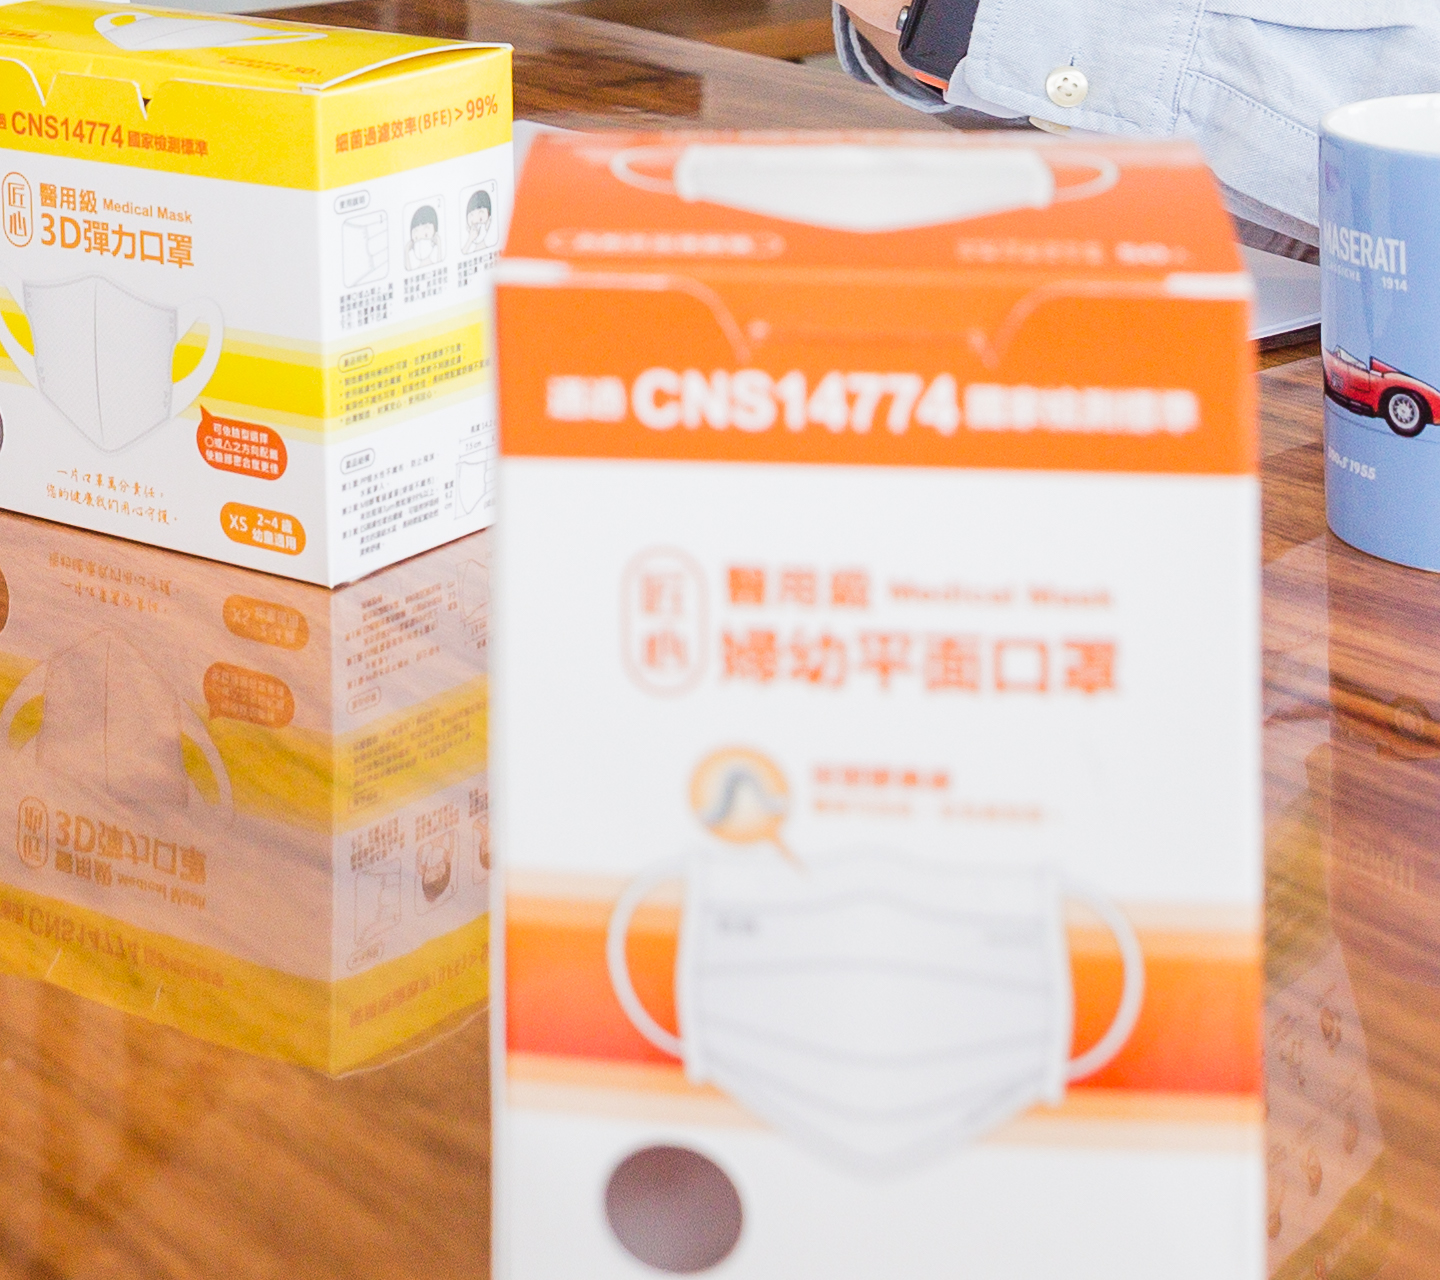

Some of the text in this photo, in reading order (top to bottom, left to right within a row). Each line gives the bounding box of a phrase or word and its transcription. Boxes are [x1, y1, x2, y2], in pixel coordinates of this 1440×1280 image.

[11, 111, 124, 148] CNS14774
[39, 182, 193, 224] 醫用級 Medical Mask
[40, 212, 195, 269] 3D彈力口罩
[1381, 276, 1408, 292] 1914
[632, 368, 961, 435] CNS14774
[1349, 460, 1376, 480] 1955
[229, 513, 248, 532] XS
